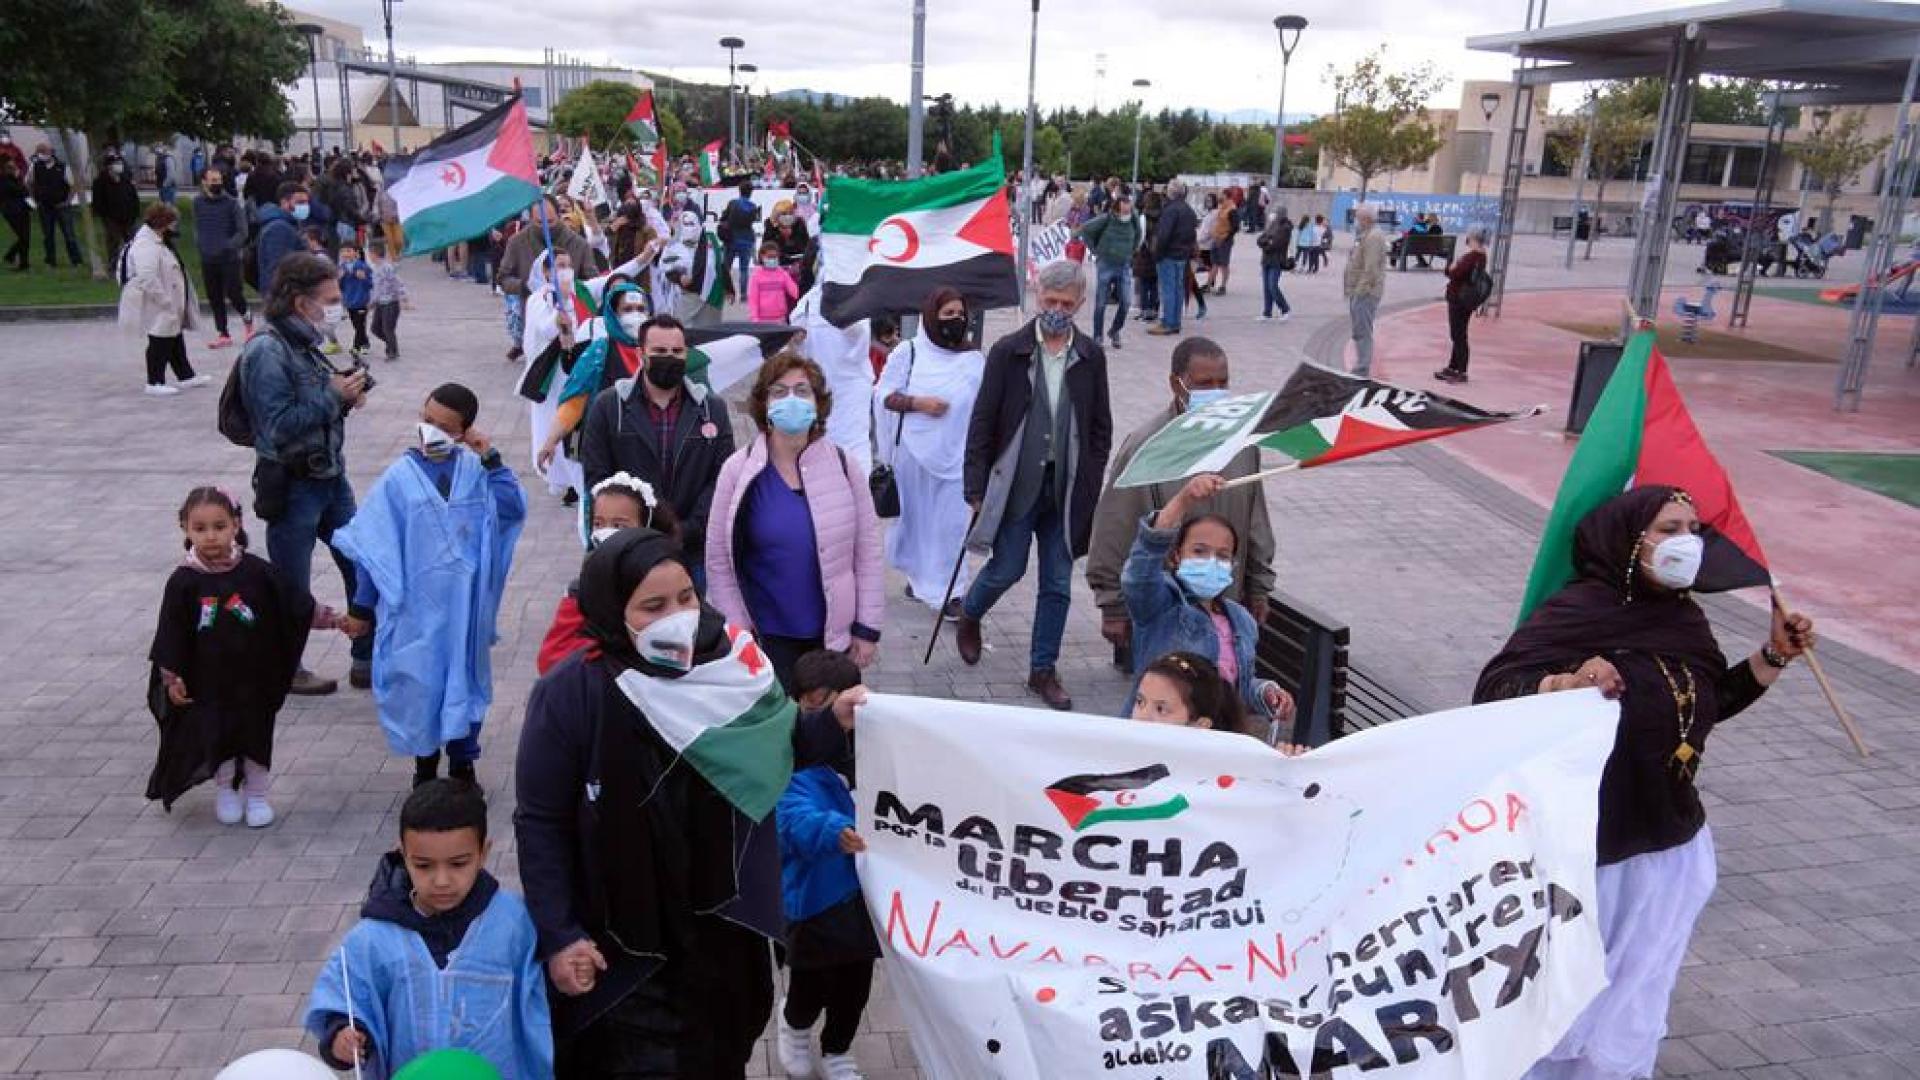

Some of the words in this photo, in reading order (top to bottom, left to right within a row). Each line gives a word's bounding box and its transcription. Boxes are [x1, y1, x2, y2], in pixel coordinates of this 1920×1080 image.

[874, 790, 1240, 878] MARCHA
[924, 833, 946, 848] la
[956, 878, 984, 895] del
